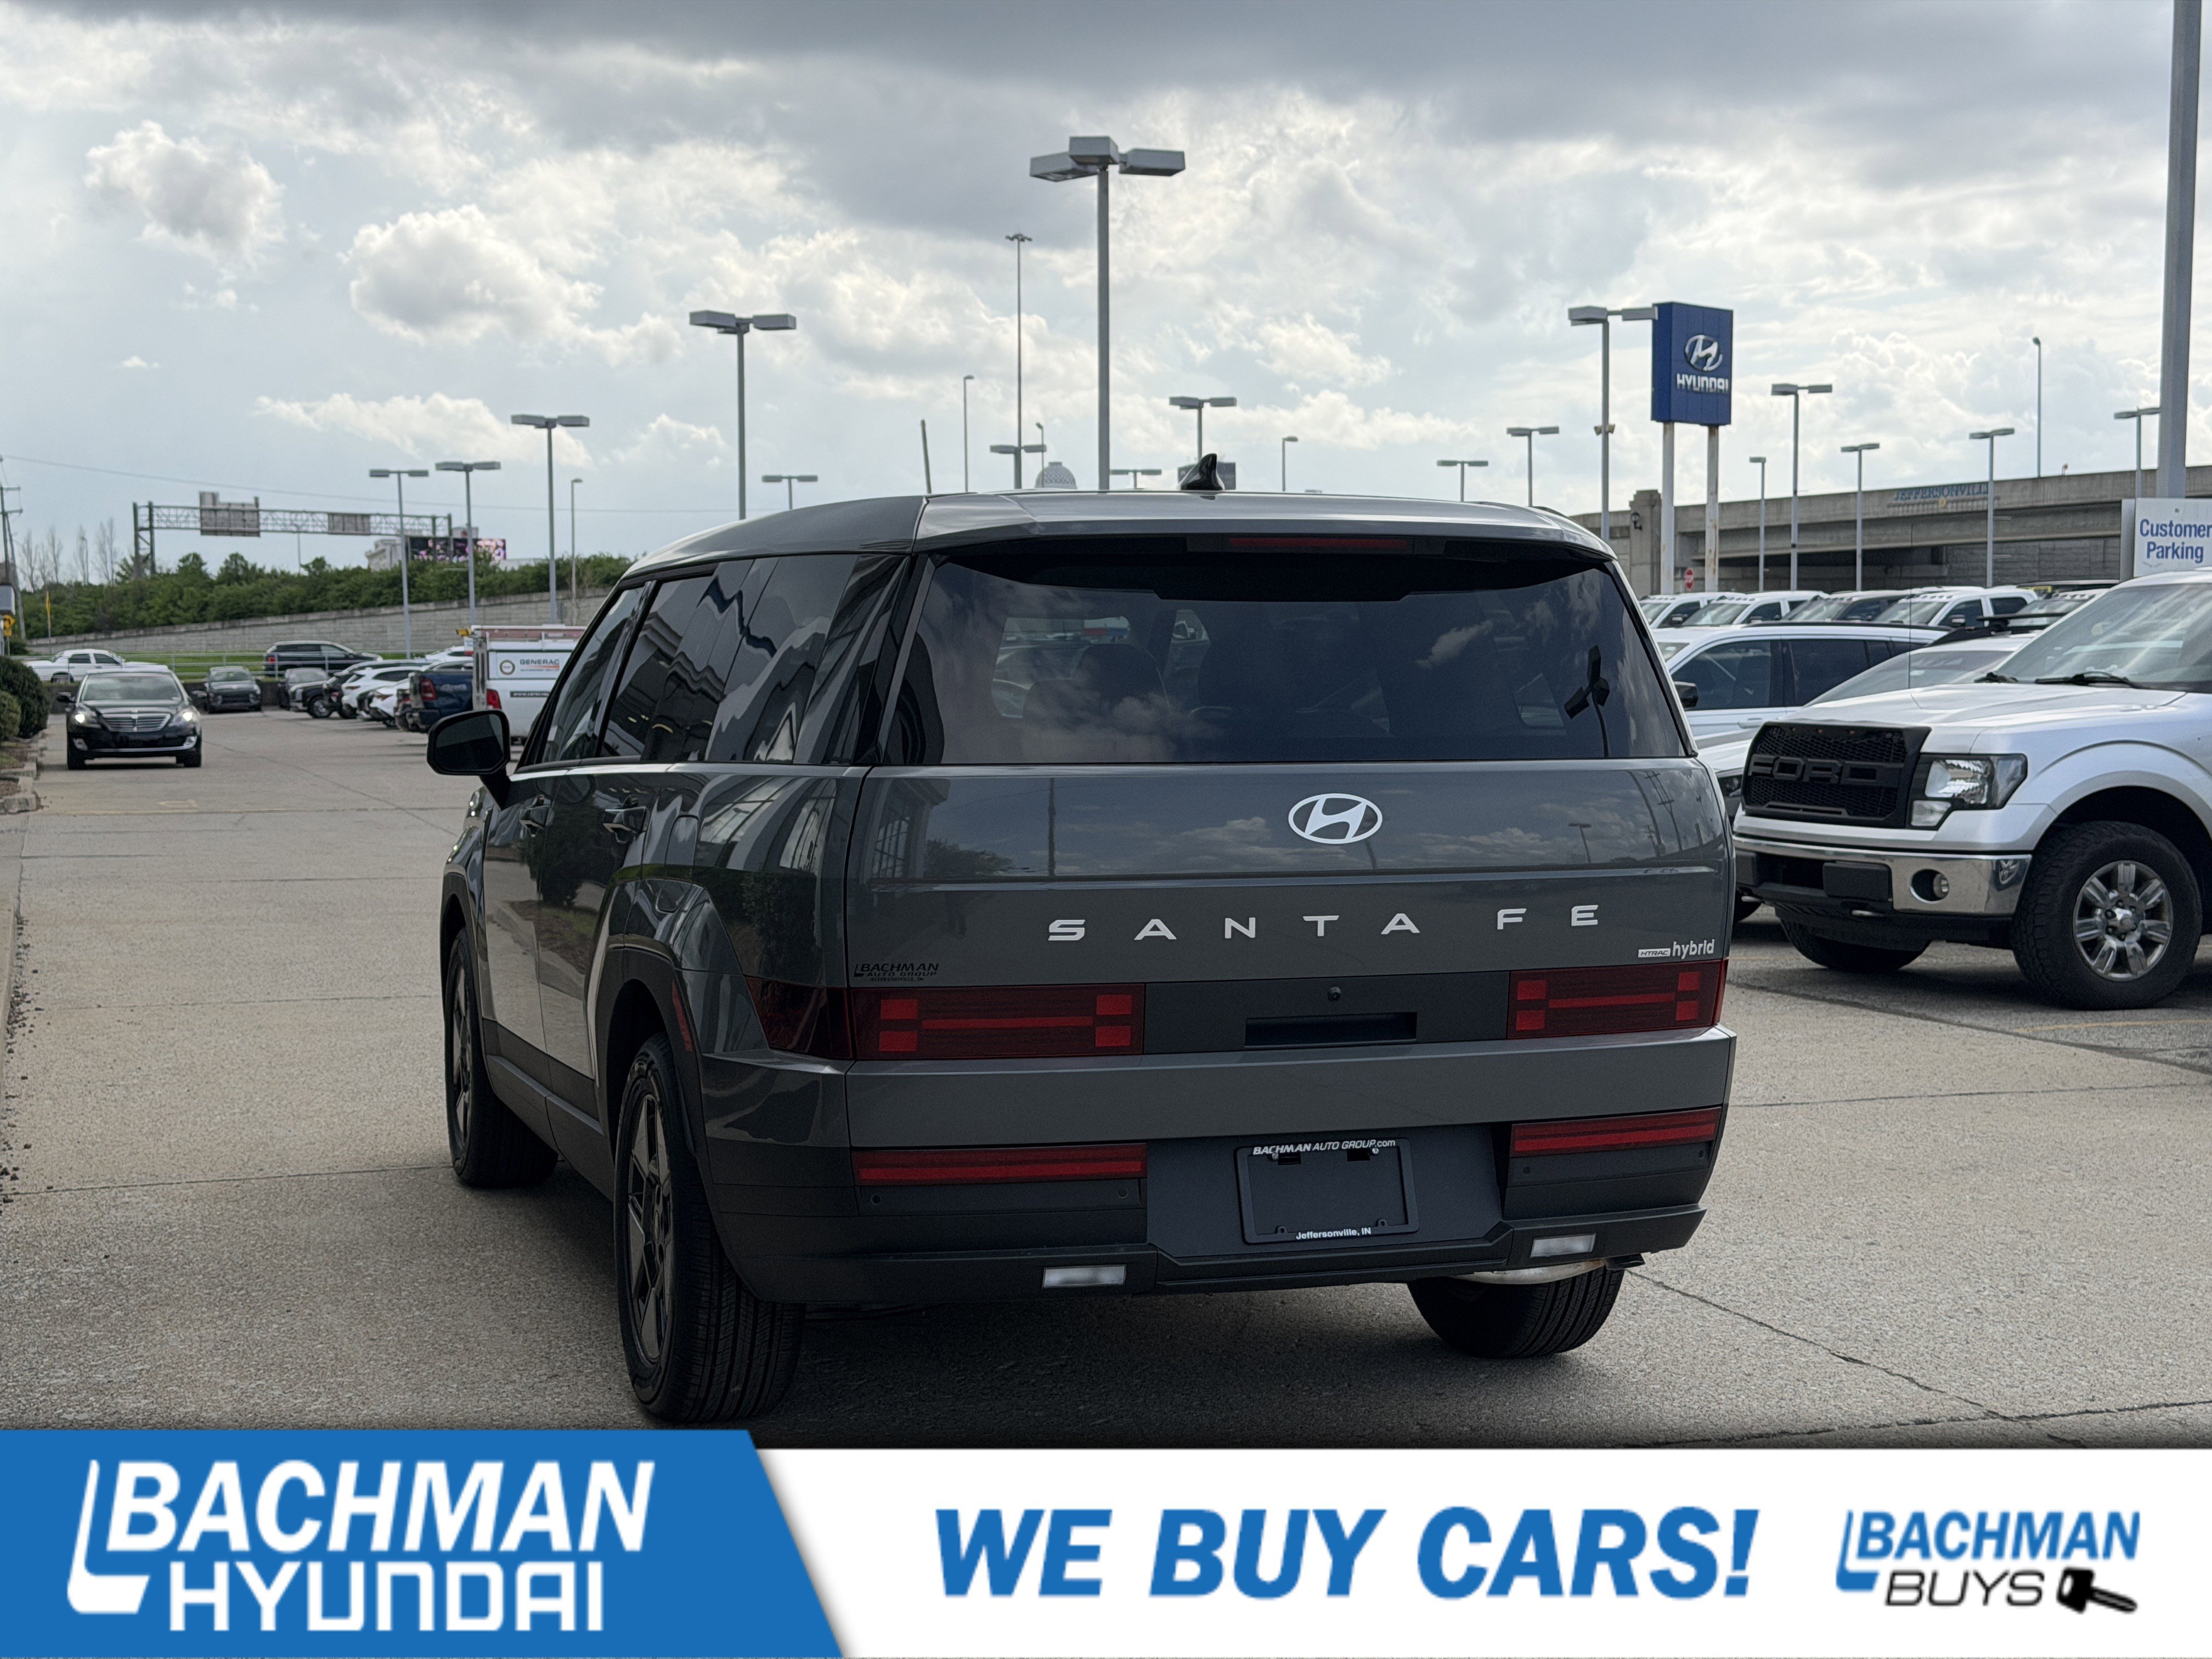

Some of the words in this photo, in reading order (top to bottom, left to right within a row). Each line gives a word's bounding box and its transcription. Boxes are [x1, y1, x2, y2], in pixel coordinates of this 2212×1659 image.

[1677, 373, 1729, 393] HYUNDAI
[1894, 482, 1989, 501] JEFFERSONVILL
[2140, 518, 2212, 538] Customer
[2146, 541, 2204, 563] Parking
[1748, 754, 1905, 788] FORD
[1047, 913, 1421, 941] SANTA
[1496, 904, 1599, 930] FE
[1672, 939, 1716, 960] hybrid
[860, 963, 939, 972] BACHMAN
[1252, 1143, 1311, 1155] BACHMAN
[1312, 1142, 1339, 1151] AUTO
[1296, 1228, 1359, 1240] Jeffersonville,
